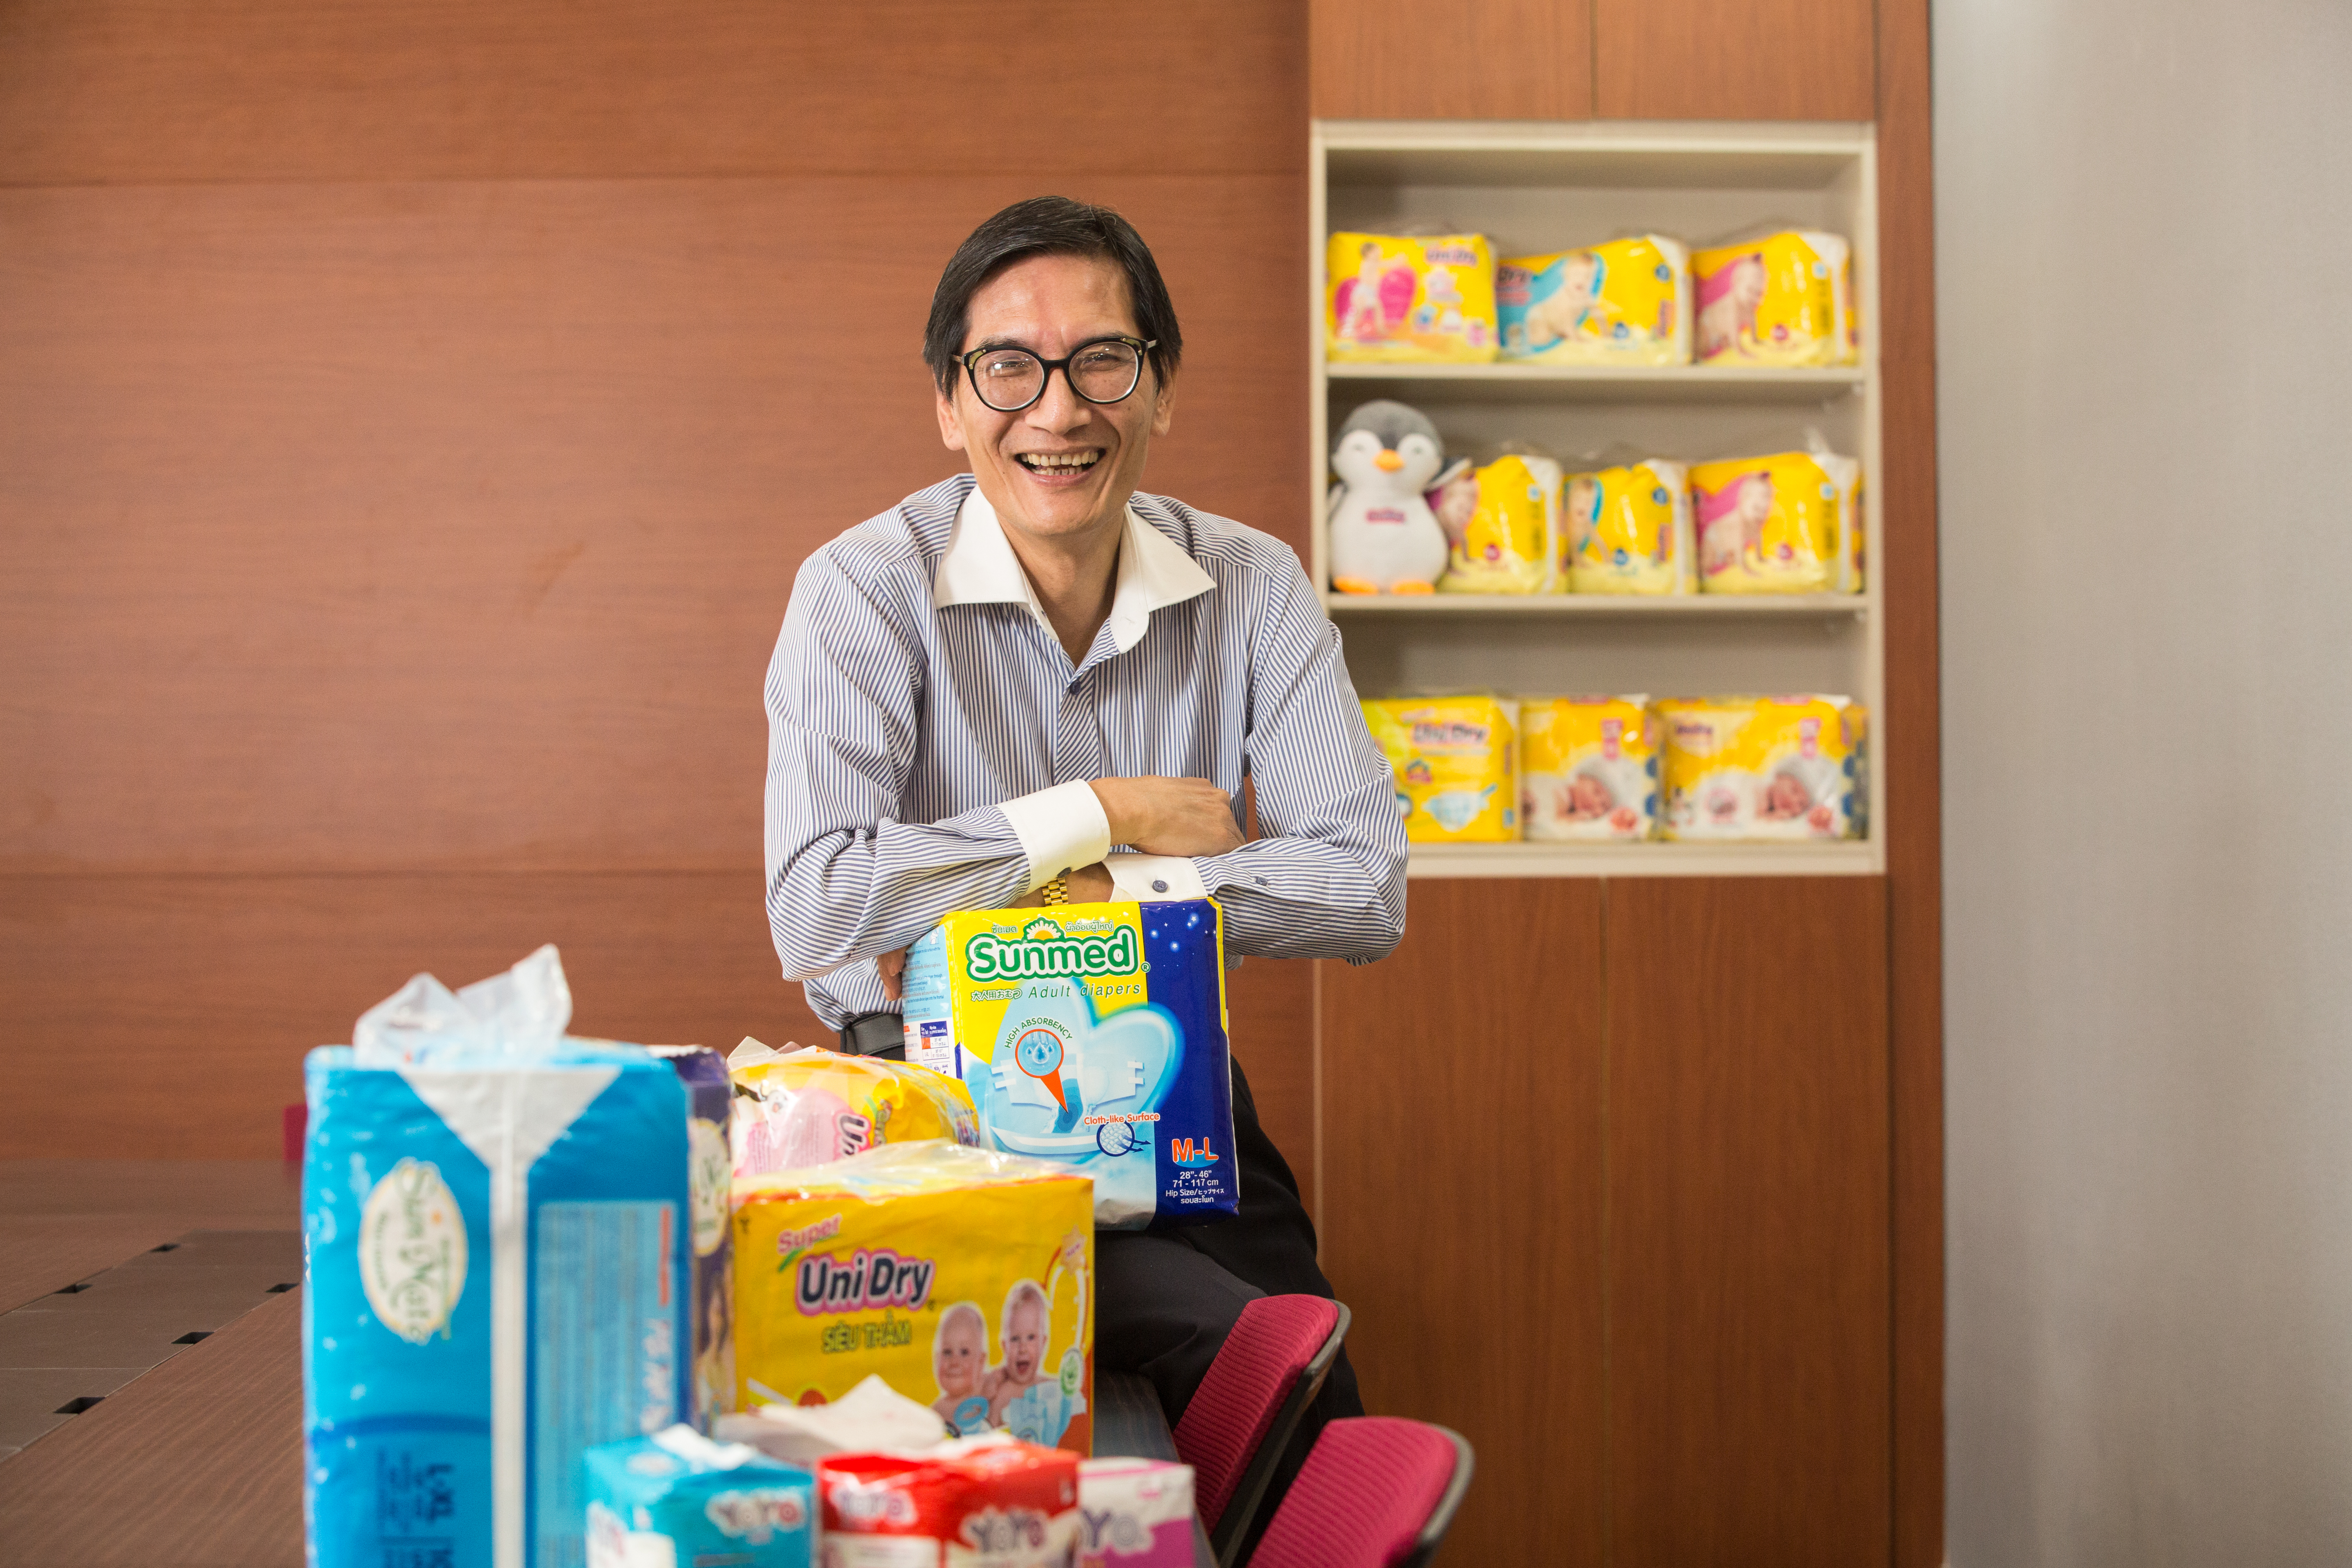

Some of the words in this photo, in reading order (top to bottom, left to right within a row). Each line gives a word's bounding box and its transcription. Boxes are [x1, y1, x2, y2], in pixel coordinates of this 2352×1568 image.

[969, 929, 1135, 978] Sunmed
[971, 988, 1022, 1002] 大人用おむつ
[1028, 985, 1071, 999] Adult
[1080, 983, 1141, 999] diapers
[1004, 1027, 1020, 1048] HIGH
[1021, 1017, 1073, 1039] ABSORBENCY
[1084, 1114, 1124, 1125] Cloth-like
[1127, 1113, 1159, 1122] Surface
[1172, 1136, 1219, 1163] M-L
[1165, 1189, 1178, 1198] Hip
[1180, 1195, 1214, 1204] รอบสะโพก
[777, 1212, 843, 1256] Super
